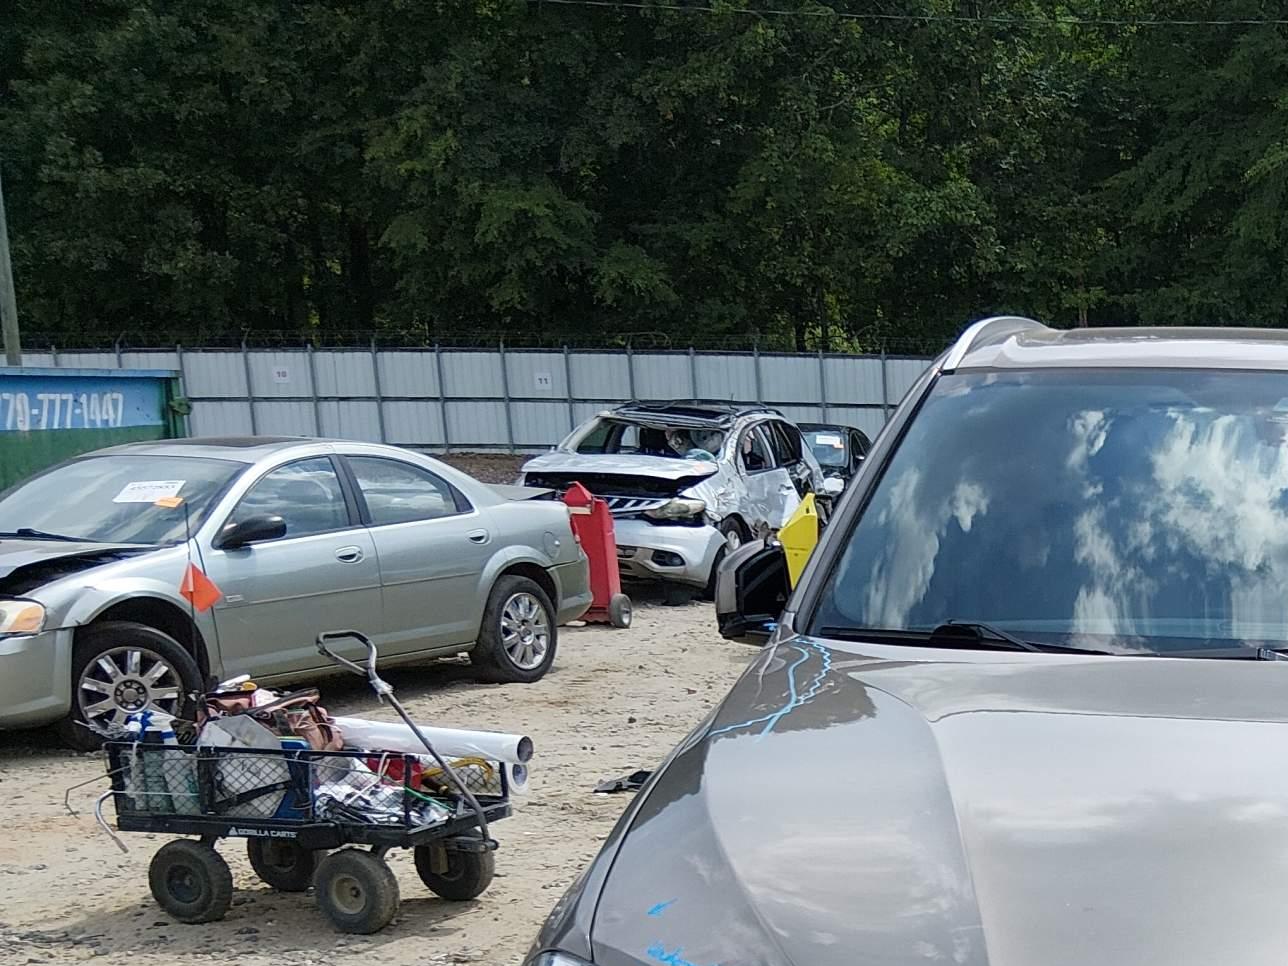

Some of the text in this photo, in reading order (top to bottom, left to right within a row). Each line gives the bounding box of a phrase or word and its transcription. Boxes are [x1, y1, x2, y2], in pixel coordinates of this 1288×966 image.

[0, 392, 123, 431] 70-777-1447
[237, 828, 298, 839] GORILLA CARTS
